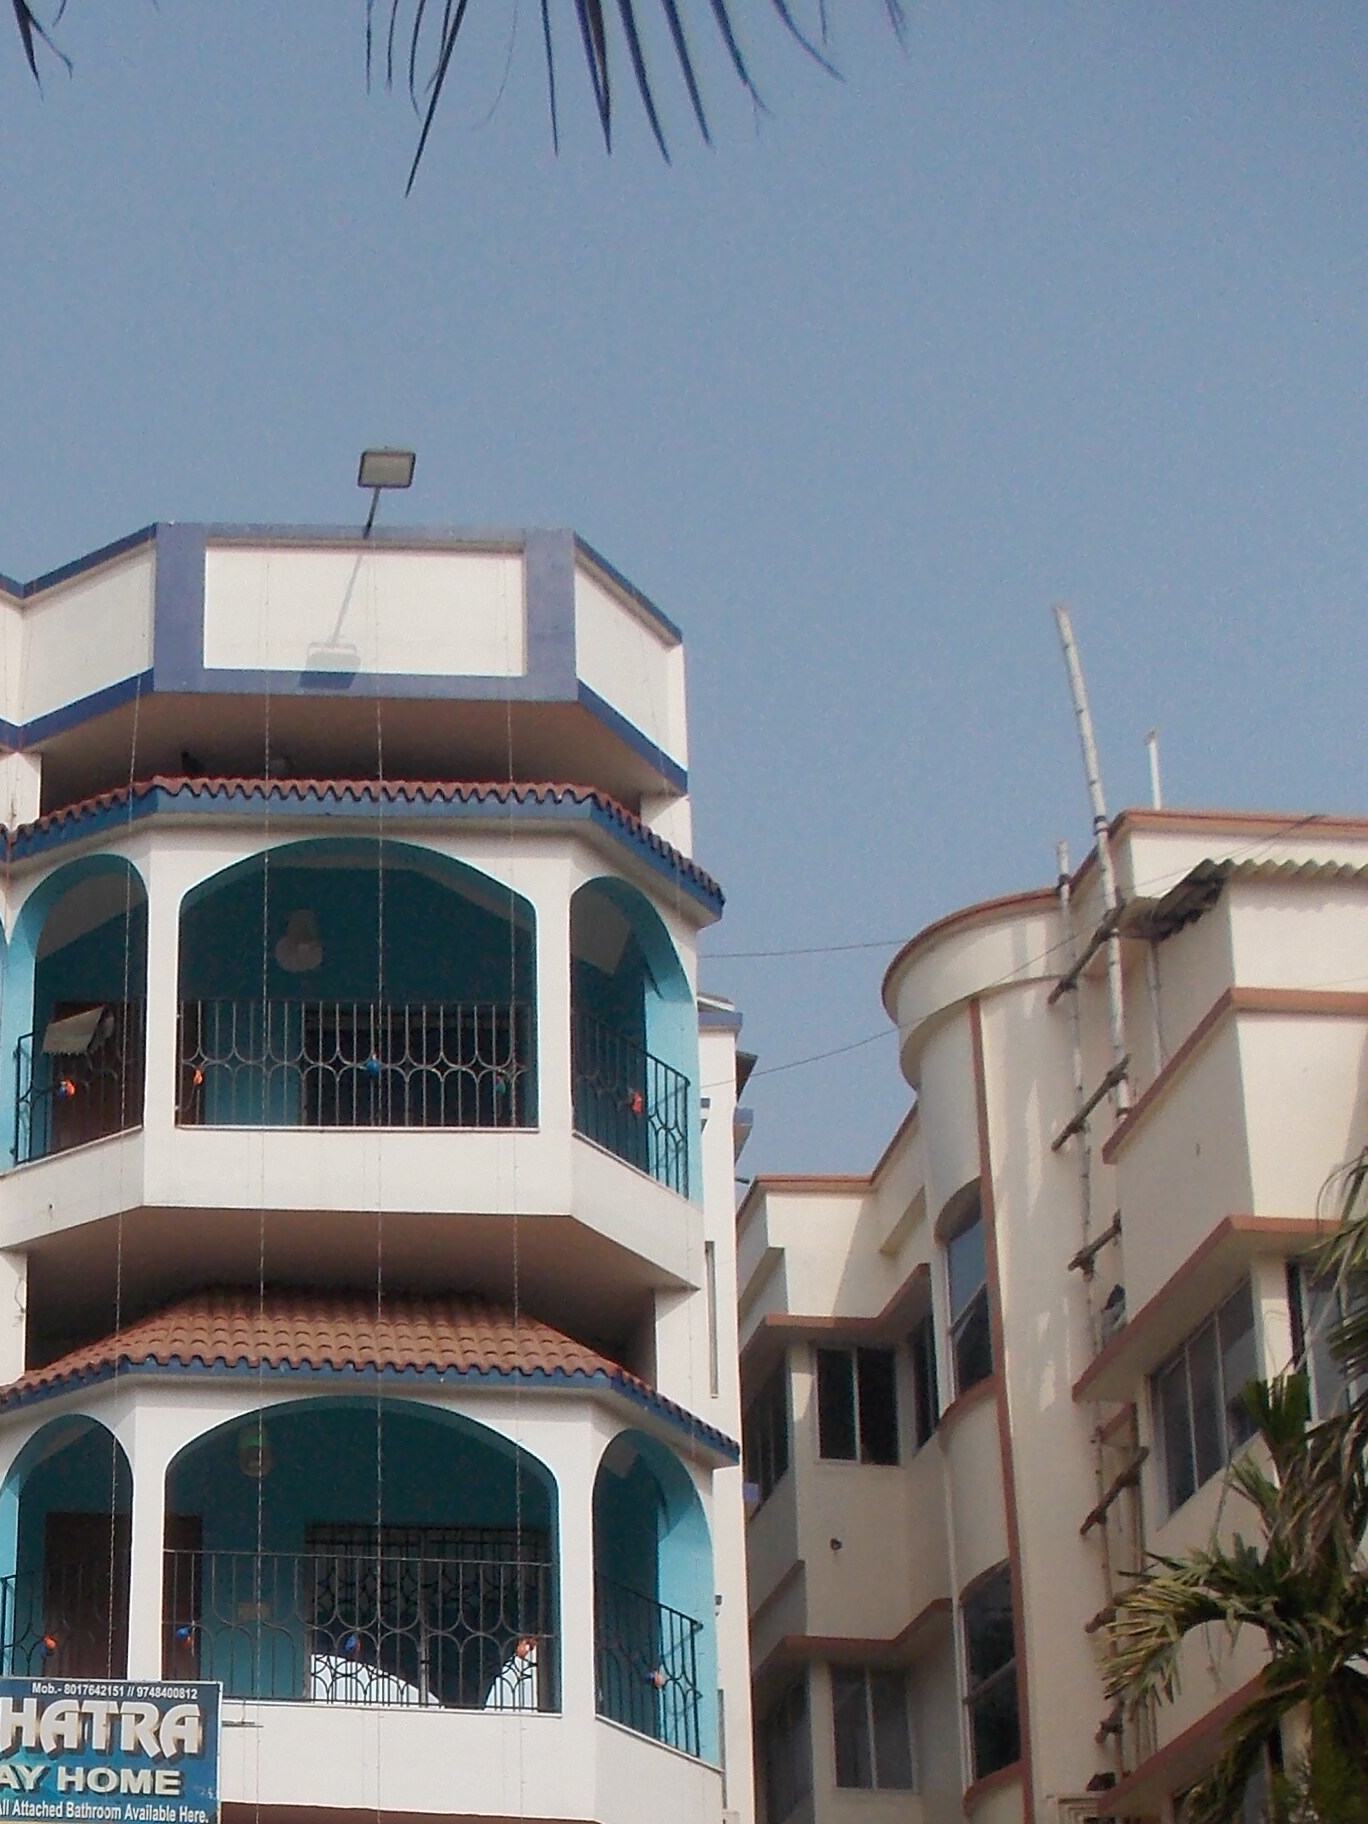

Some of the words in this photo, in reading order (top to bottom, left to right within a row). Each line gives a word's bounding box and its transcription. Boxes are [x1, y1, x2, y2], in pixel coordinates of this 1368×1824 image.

[32, 1682, 62, 1694] Mob.-
[64, 1683, 124, 1697] 8017642151
[137, 1686, 198, 1700] 9748400812
[57, 1767, 181, 1796] HOME
[12, 1800, 63, 1818] Attached
[66, 1802, 121, 1820] Bathroom
[124, 1803, 176, 1822] Available
[179, 1806, 209, 1824] Here.
